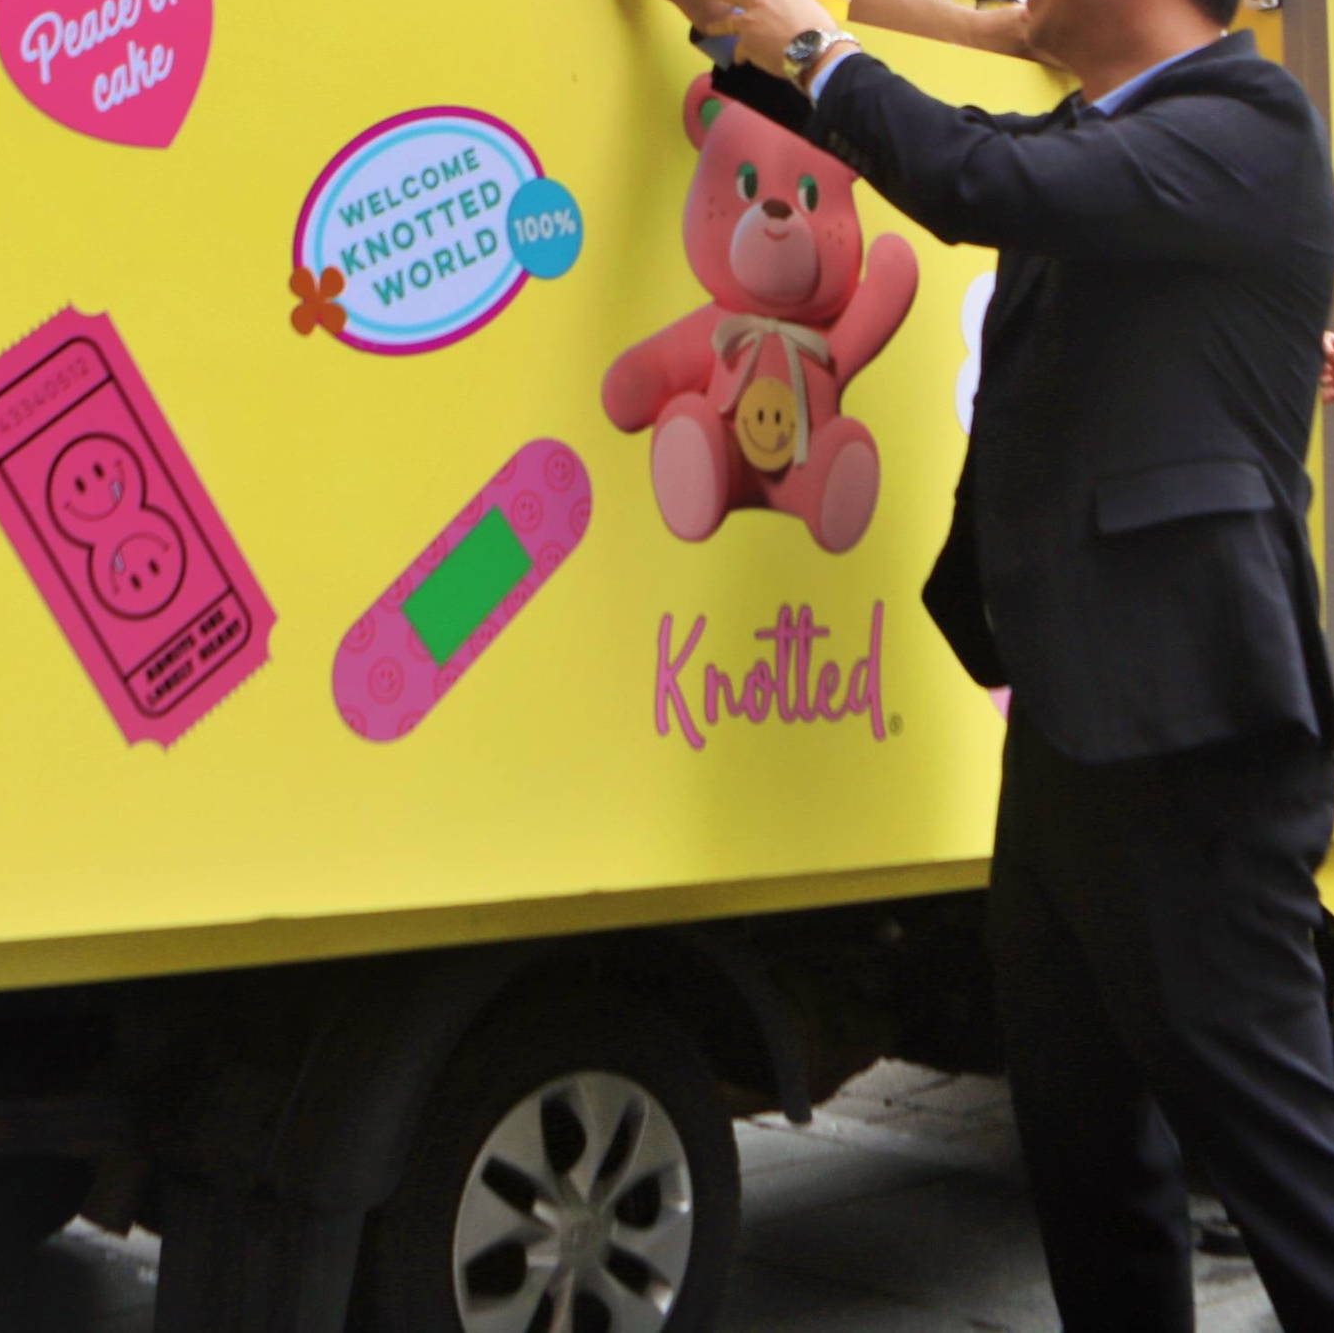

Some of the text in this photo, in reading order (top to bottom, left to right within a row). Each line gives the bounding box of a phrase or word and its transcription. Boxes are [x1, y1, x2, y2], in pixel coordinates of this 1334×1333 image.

[92, 42, 174, 112] cake
[338, 148, 481, 228] WELCOME
[514, 209, 577, 244] 100%
[340, 180, 503, 277] KNOTTED
[373, 228, 498, 307] WORLD
